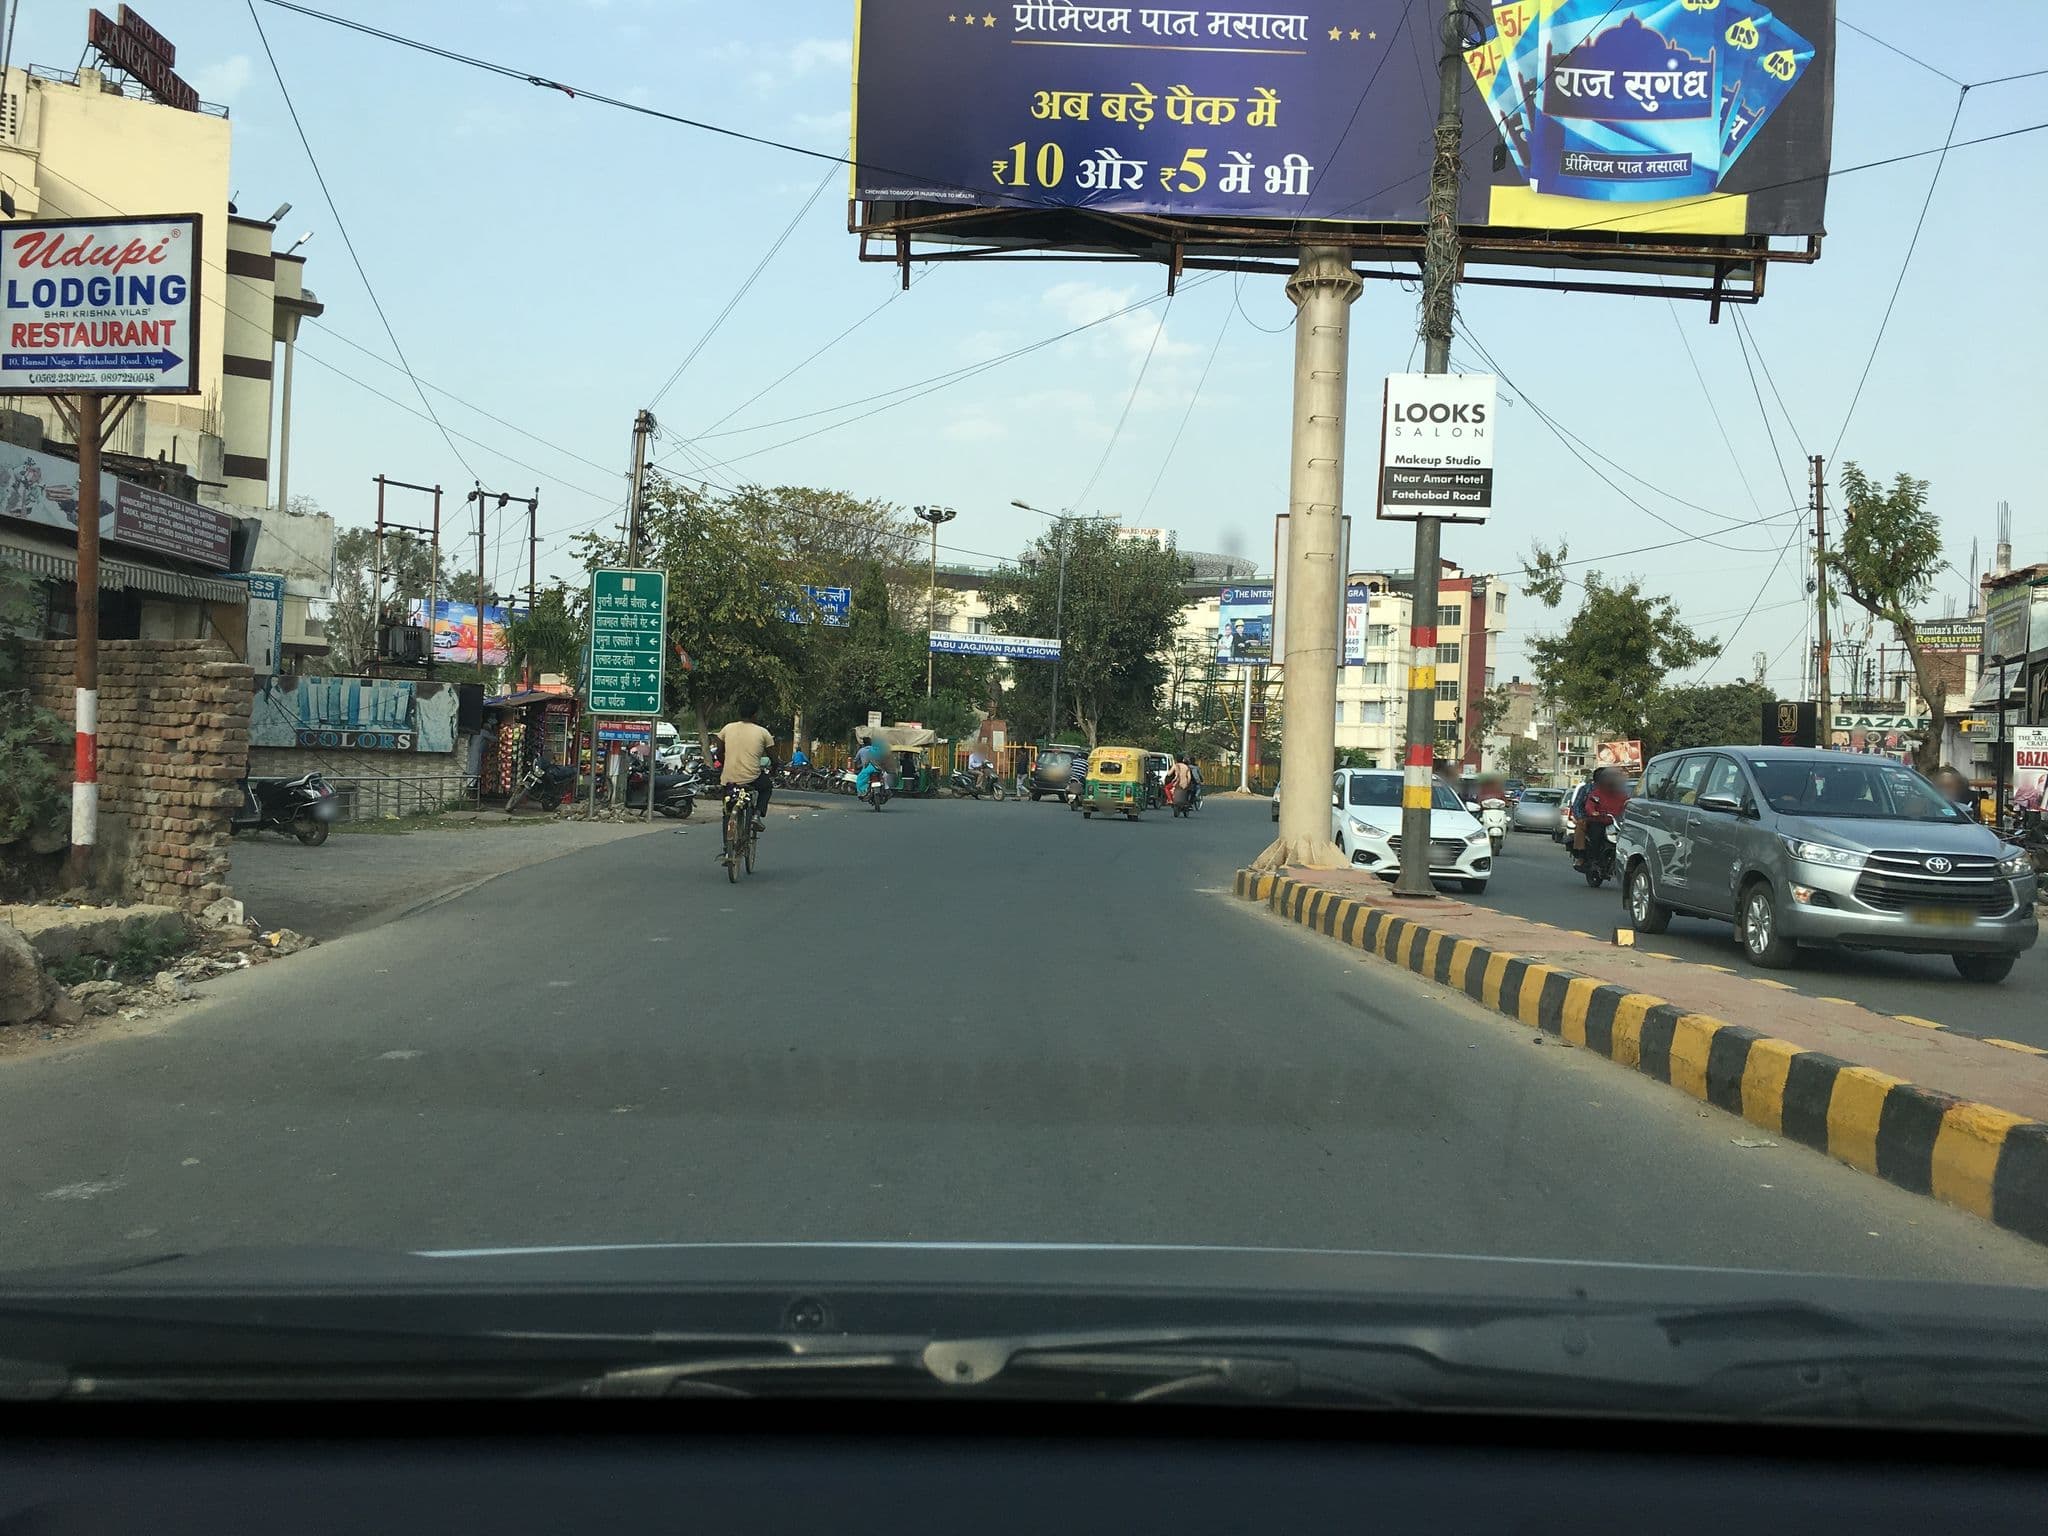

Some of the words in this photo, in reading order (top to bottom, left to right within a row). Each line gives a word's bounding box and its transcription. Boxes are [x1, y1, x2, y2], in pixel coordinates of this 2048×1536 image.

[1013, 0, 1132, 34] प्रीमियम
[1139, 9, 1199, 36] पान
[1206, 11, 1309, 40] मसाला
[1554, 67, 1615, 99] राज
[1622, 59, 1708, 112] सुगंध
[1030, 91, 1093, 121] अब
[1101, 82, 1158, 131] बड़े
[1165, 85, 1239, 125] पैक
[1246, 87, 1281, 127] में
[1076, 147, 1148, 190] और
[1219, 151, 1255, 193] में
[1264, 153, 1314, 195] भी
[1565, 153, 1615, 173] प्रीमियम
[1617, 161, 1643, 174] पान
[1646, 159, 1689, 173] मसाला
[13, 231, 169, 275] Udupi
[7, 275, 187, 308] LODGING
[44, 310, 69, 318] SHRI
[73, 309, 117, 318] KRISHNA
[11, 320, 176, 348] RESTAURANT
[22, 356, 48, 366] Bansal
[144, 355, 163, 367] Agra
[1394, 403, 1486, 424] LOOKS
[1395, 427, 1484, 438] SALON
[1395, 455, 1442, 467] Makeup
[1445, 456, 1481, 466] Studio
[1393, 474, 1420, 483] Near
[1423, 474, 1452, 484] Amar
[1455, 475, 1484, 484] Hotel
[1392, 490, 1450, 500] Fatehabad
[1452, 491, 1481, 501] Road
[1234, 590, 1249, 598] THE
[1915, 625, 1952, 635] Mumtaz's
[1952, 624, 1982, 635] Kitchen
[1916, 634, 1982, 643] Restaurant
[930, 640, 956, 649] BABU
[958, 642, 1002, 652] JAGJIVAN
[1004, 645, 1024, 654] RAM
[1026, 647, 1060, 656] CHOWK
[300, 731, 411, 749] COLORS
